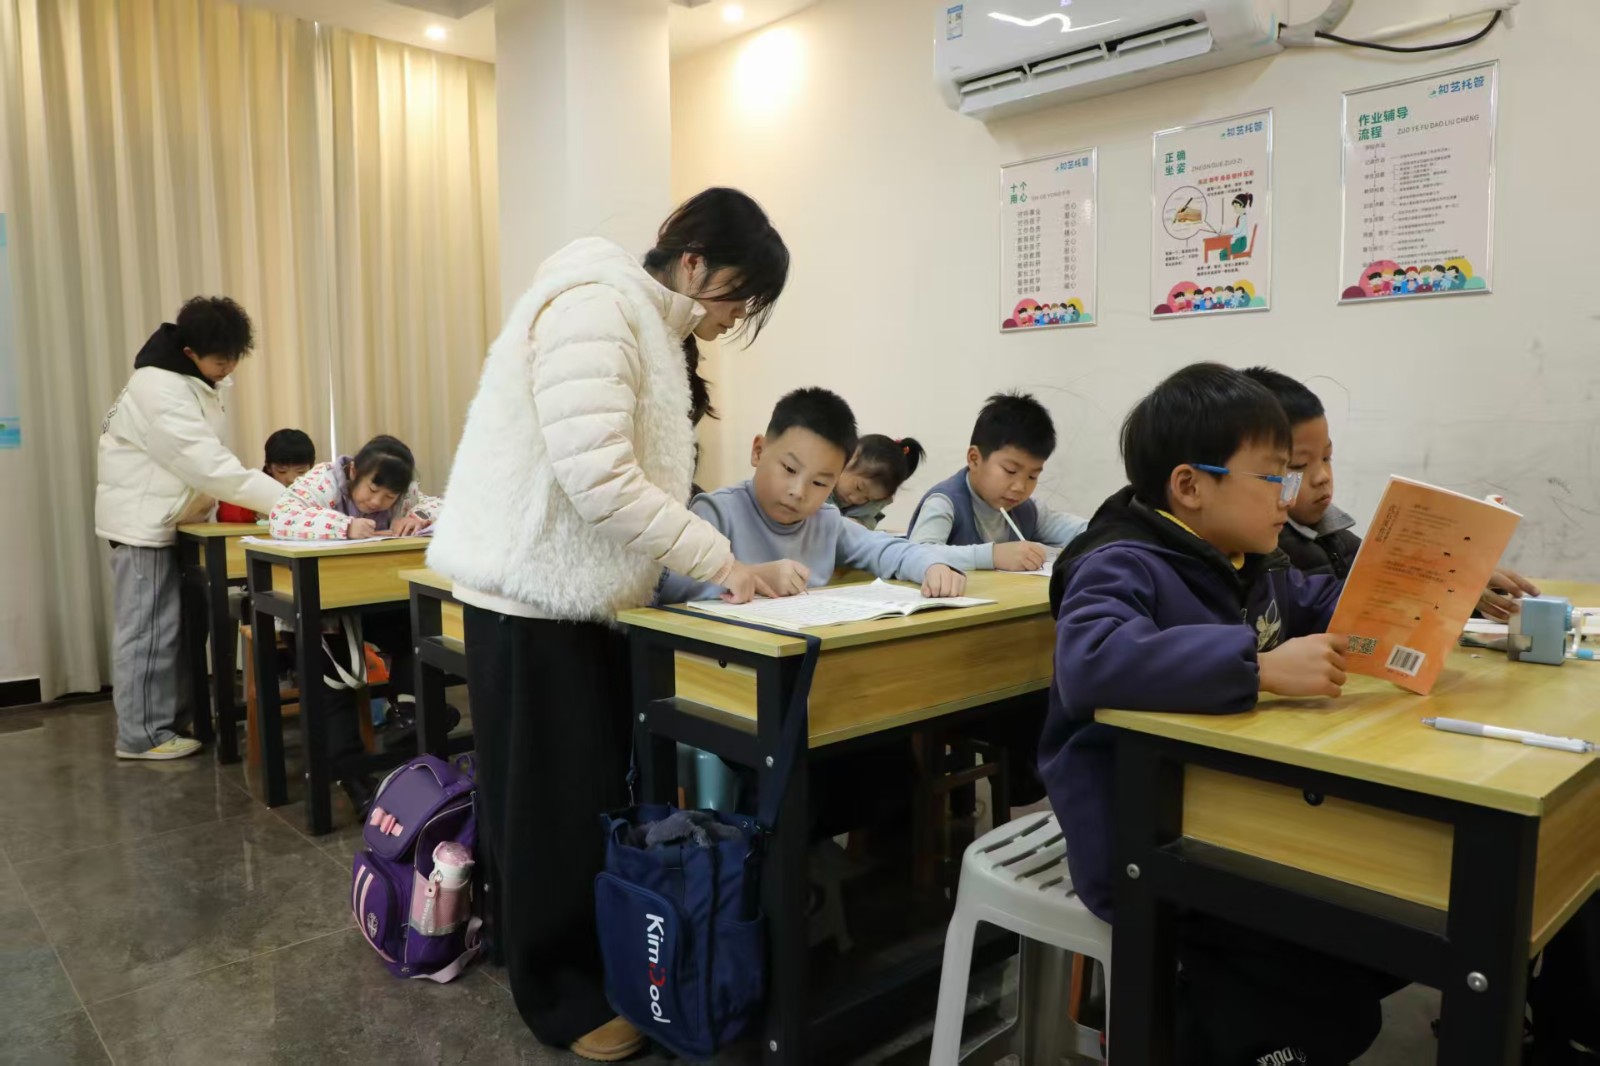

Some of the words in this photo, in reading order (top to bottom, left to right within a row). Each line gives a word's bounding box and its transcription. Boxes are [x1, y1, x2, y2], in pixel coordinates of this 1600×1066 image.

[1438, 76, 1485, 94] 知艺托管
[1358, 106, 1408, 126] 作业辅导
[1429, 121, 1443, 129] DAO
[1456, 114, 1479, 124] CHENG
[1358, 126, 1382, 141] 流程
[1165, 150, 1186, 163] 正确
[1165, 163, 1186, 176] 坐姿
[1010, 181, 1027, 193] 十个
[1010, 192, 1027, 204] 用心
